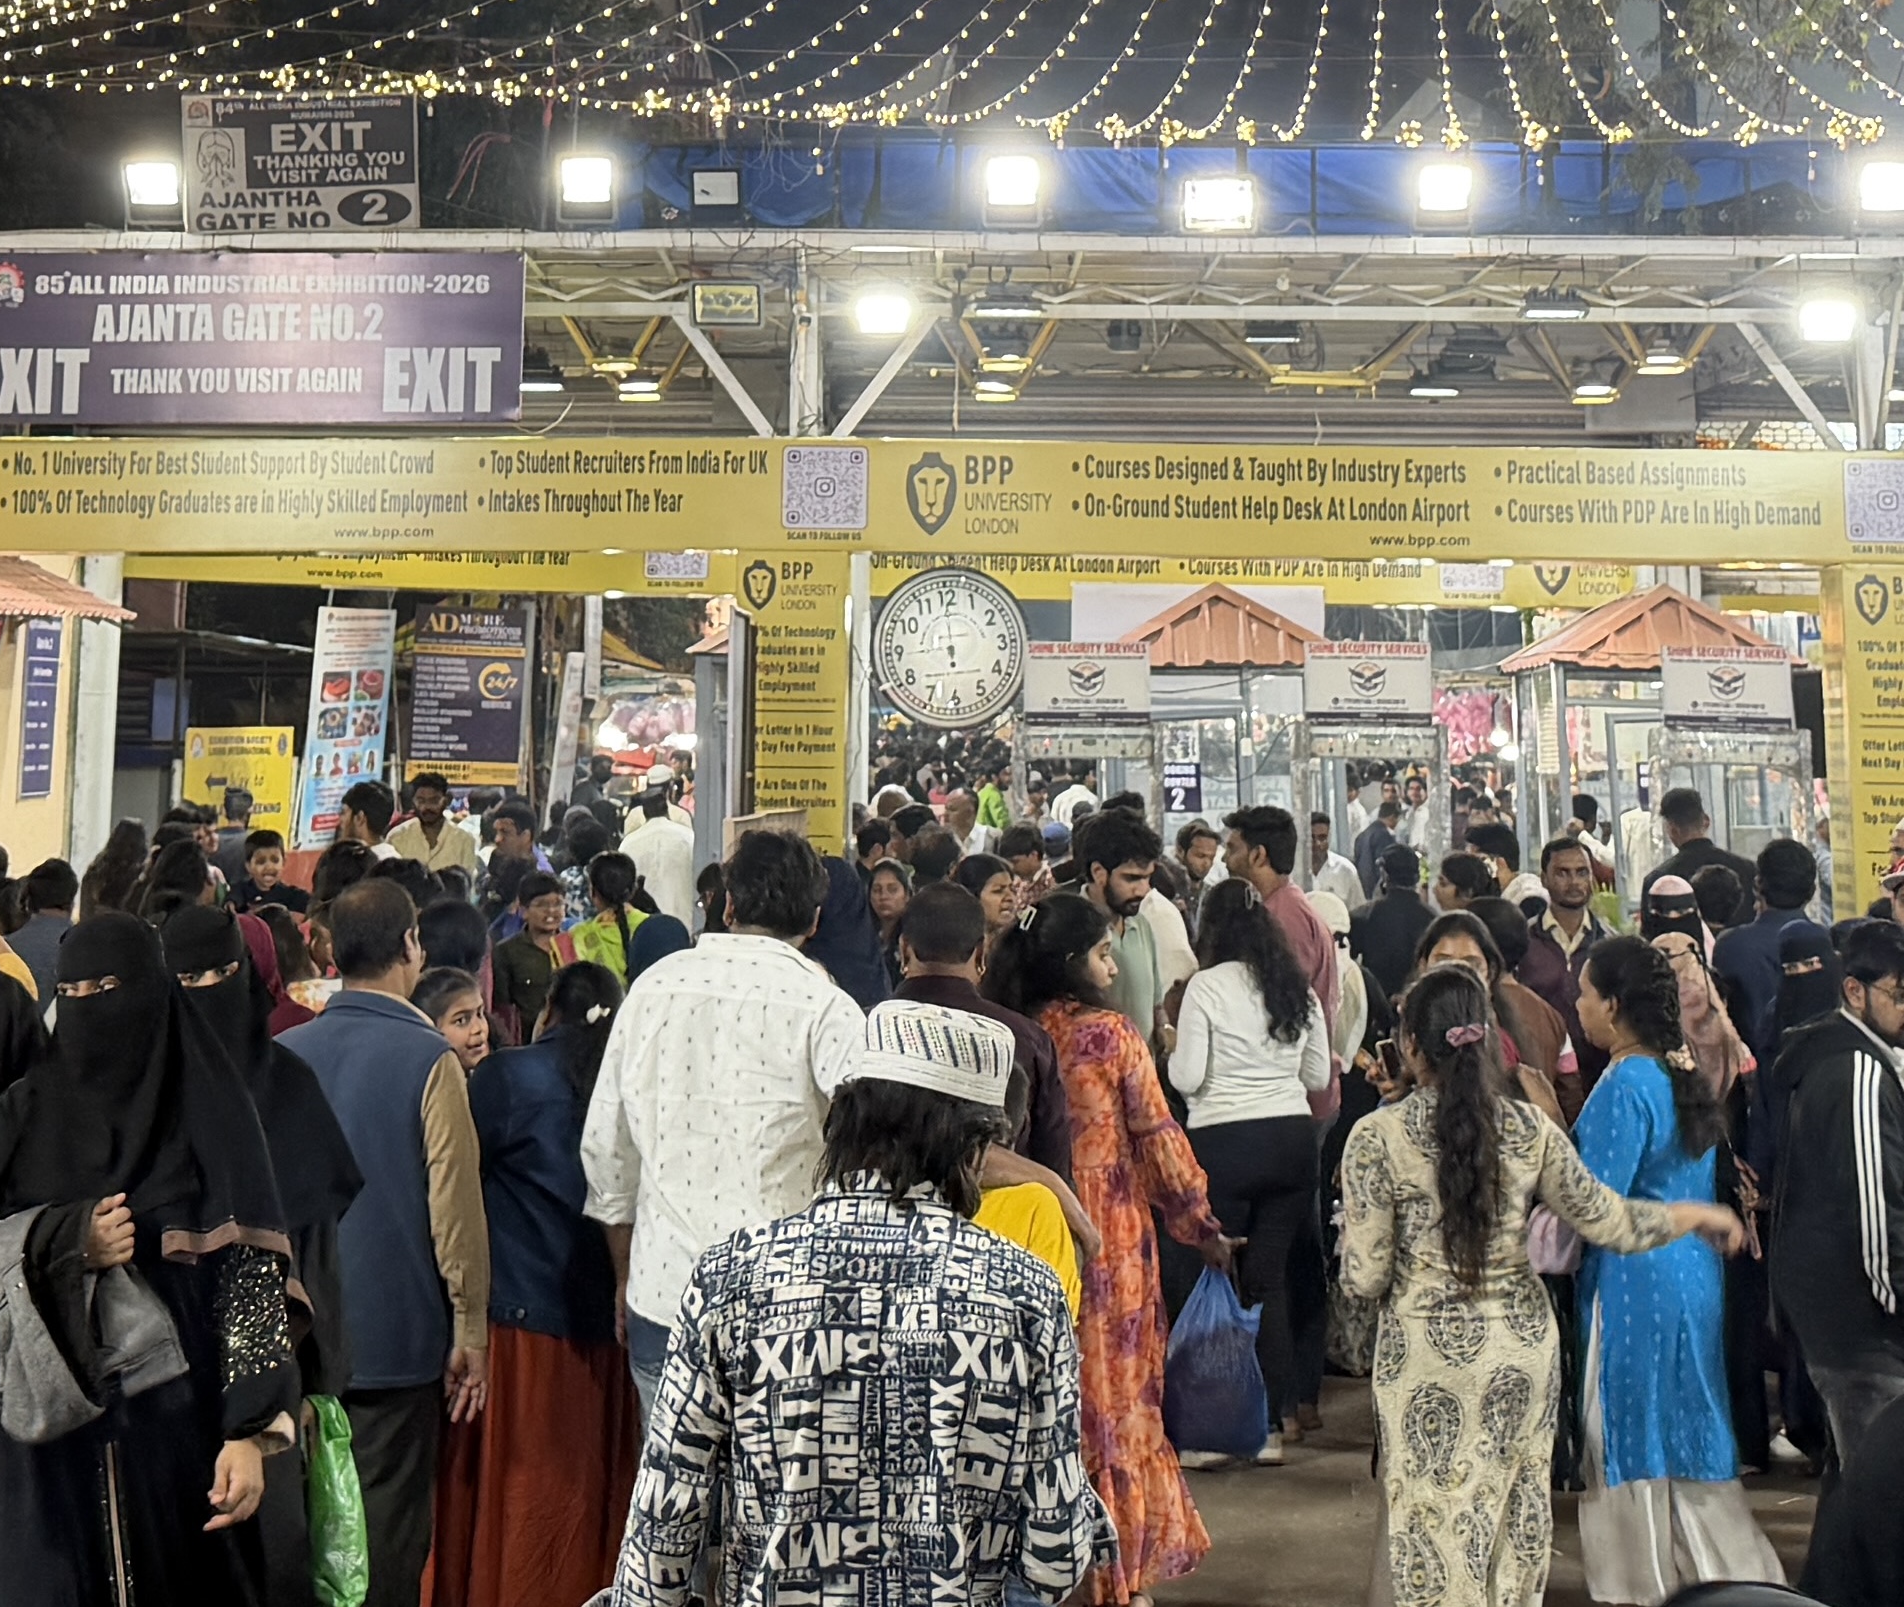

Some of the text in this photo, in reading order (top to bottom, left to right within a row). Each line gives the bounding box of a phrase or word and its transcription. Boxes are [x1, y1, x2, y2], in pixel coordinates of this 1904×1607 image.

[248, 99, 266, 111] ALL
[267, 99, 293, 111] INDIA
[294, 98, 348, 110] INDUSTRIAL
[349, 98, 402, 109] EXHIBITION
[270, 121, 372, 153] EXIT
[253, 151, 405, 170] THANKING YOU
[267, 166, 388, 184] VISIT AGAIN
[199, 190, 322, 209] AJANTHA
[362, 192, 389, 222] 2
[196, 211, 331, 231] GATE NO
[68, 275, 105, 294] ALL
[109, 275, 170, 294] INDIA
[174, 275, 301, 294] INDUSTRIAL
[304, 274, 490, 294] EXHIBITION-2026
[92, 303, 383, 342] AJANTA GATE NO.2
[111, 367, 183, 394] THANK
[187, 367, 232, 393] YOU
[236, 367, 294, 393] VISIT
[296, 367, 363, 393] AGAIN
[381, 346, 502, 413] EXIT
[13, 449, 434, 481] No. 1 University For Best Student Support By Student Crowd
[490, 449, 768, 478] Top Student Recruiters From India For UK
[964, 454, 1014, 485] BPP
[1084, 454, 1467, 488] Courses Designed & Taught By Industry Experts
[1507, 459, 1746, 493] Practical Based Assignments
[11, 488, 468, 519] 100% Of Technology Graduates are in Highly Skilled Employment
[488, 488, 684, 518] Intakes Throughout The Year
[964, 492, 1052, 512] UNIVERSITY
[1084, 493, 1470, 527] On-Ground Student Help Desk At London Airport
[1507, 499, 1822, 531] Courses With PDP Are In High Demand
[334, 526, 434, 540] www.bpp.com
[964, 517, 1019, 535] LONDON
[1369, 534, 1471, 549] www.bpp.com
[781, 561, 814, 580] BPP
[916, 598, 932, 616] 11
[938, 589, 957, 607] 12
[421, 612, 460, 633] AD
[899, 616, 919, 635] 10
[984, 608, 996, 626] 2
[1057, 643, 1101, 654] SECURITY
[1104, 643, 1147, 654] SERVICES
[1170, 787, 1185, 811] 2
